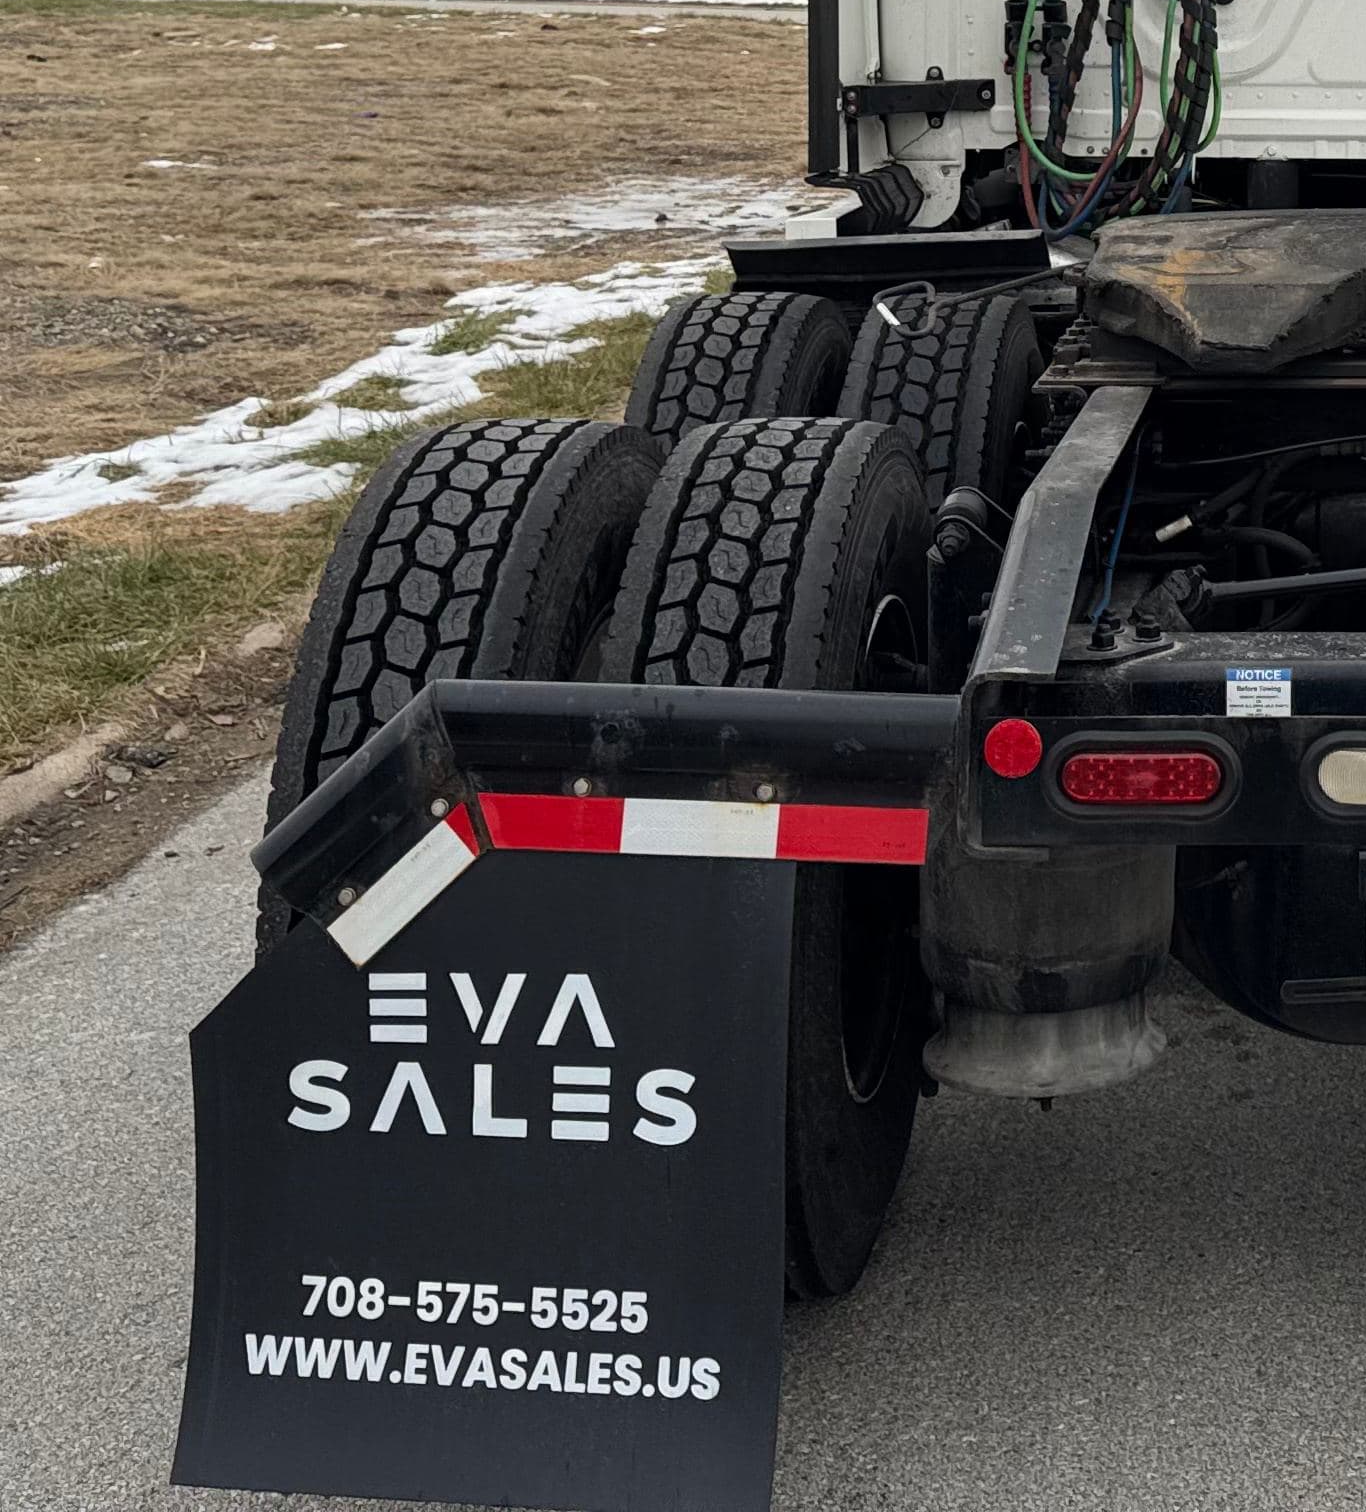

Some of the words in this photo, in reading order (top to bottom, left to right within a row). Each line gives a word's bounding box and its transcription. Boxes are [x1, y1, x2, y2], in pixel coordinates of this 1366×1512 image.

[1236, 669, 1282, 681] NOTICE
[1259, 685, 1282, 694] Towing
[368, 972, 616, 1048] EVA
[287, 1059, 697, 1146] SALES
[301, 1274, 649, 1334] 708-575-5525
[245, 1333, 721, 1401] WWW.EVASALES.US
